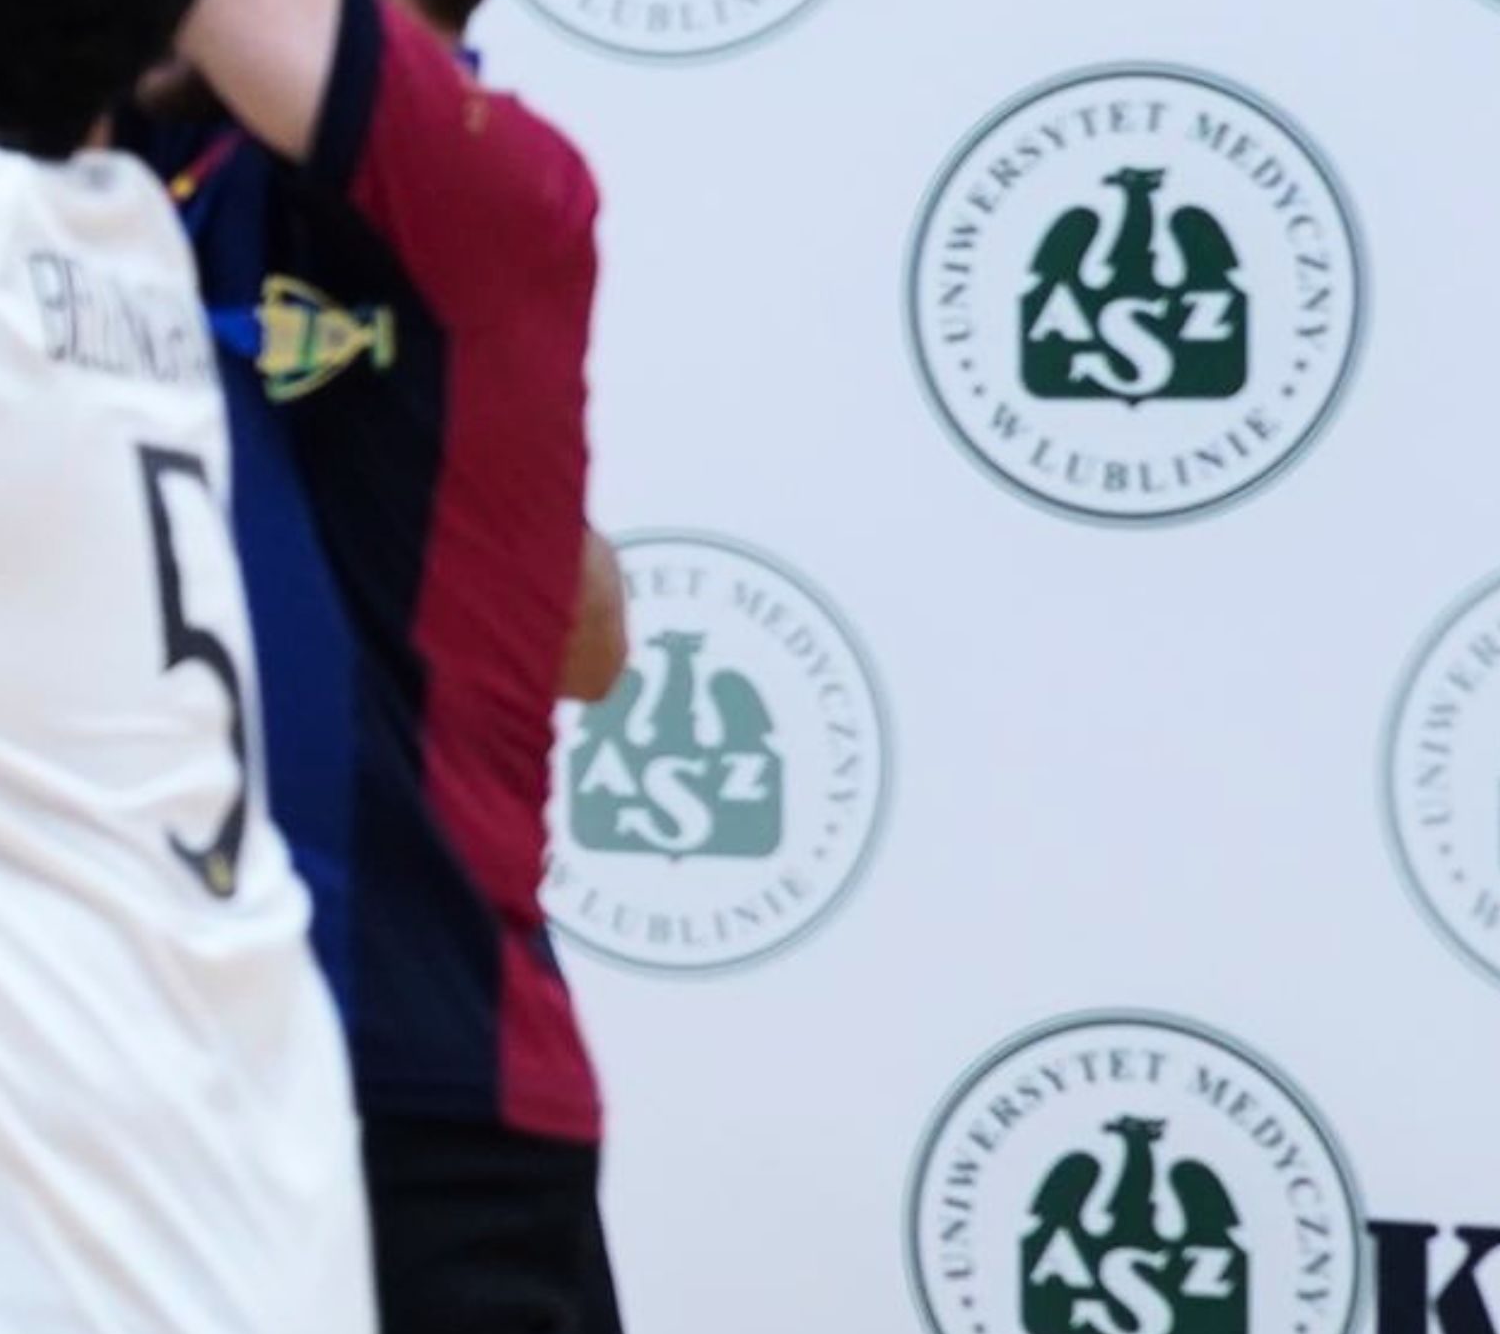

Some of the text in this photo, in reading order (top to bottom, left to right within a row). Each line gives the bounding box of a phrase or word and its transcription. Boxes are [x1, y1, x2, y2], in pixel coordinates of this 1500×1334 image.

[937, 99, 1335, 350] UNIWERSYTET MEDYCZNY
[985, 400, 1280, 494] W LUBLINIE
[137, 443, 250, 898] 5
[932, 1047, 1336, 1319] UNIWERSYTET MEDYCZNY
